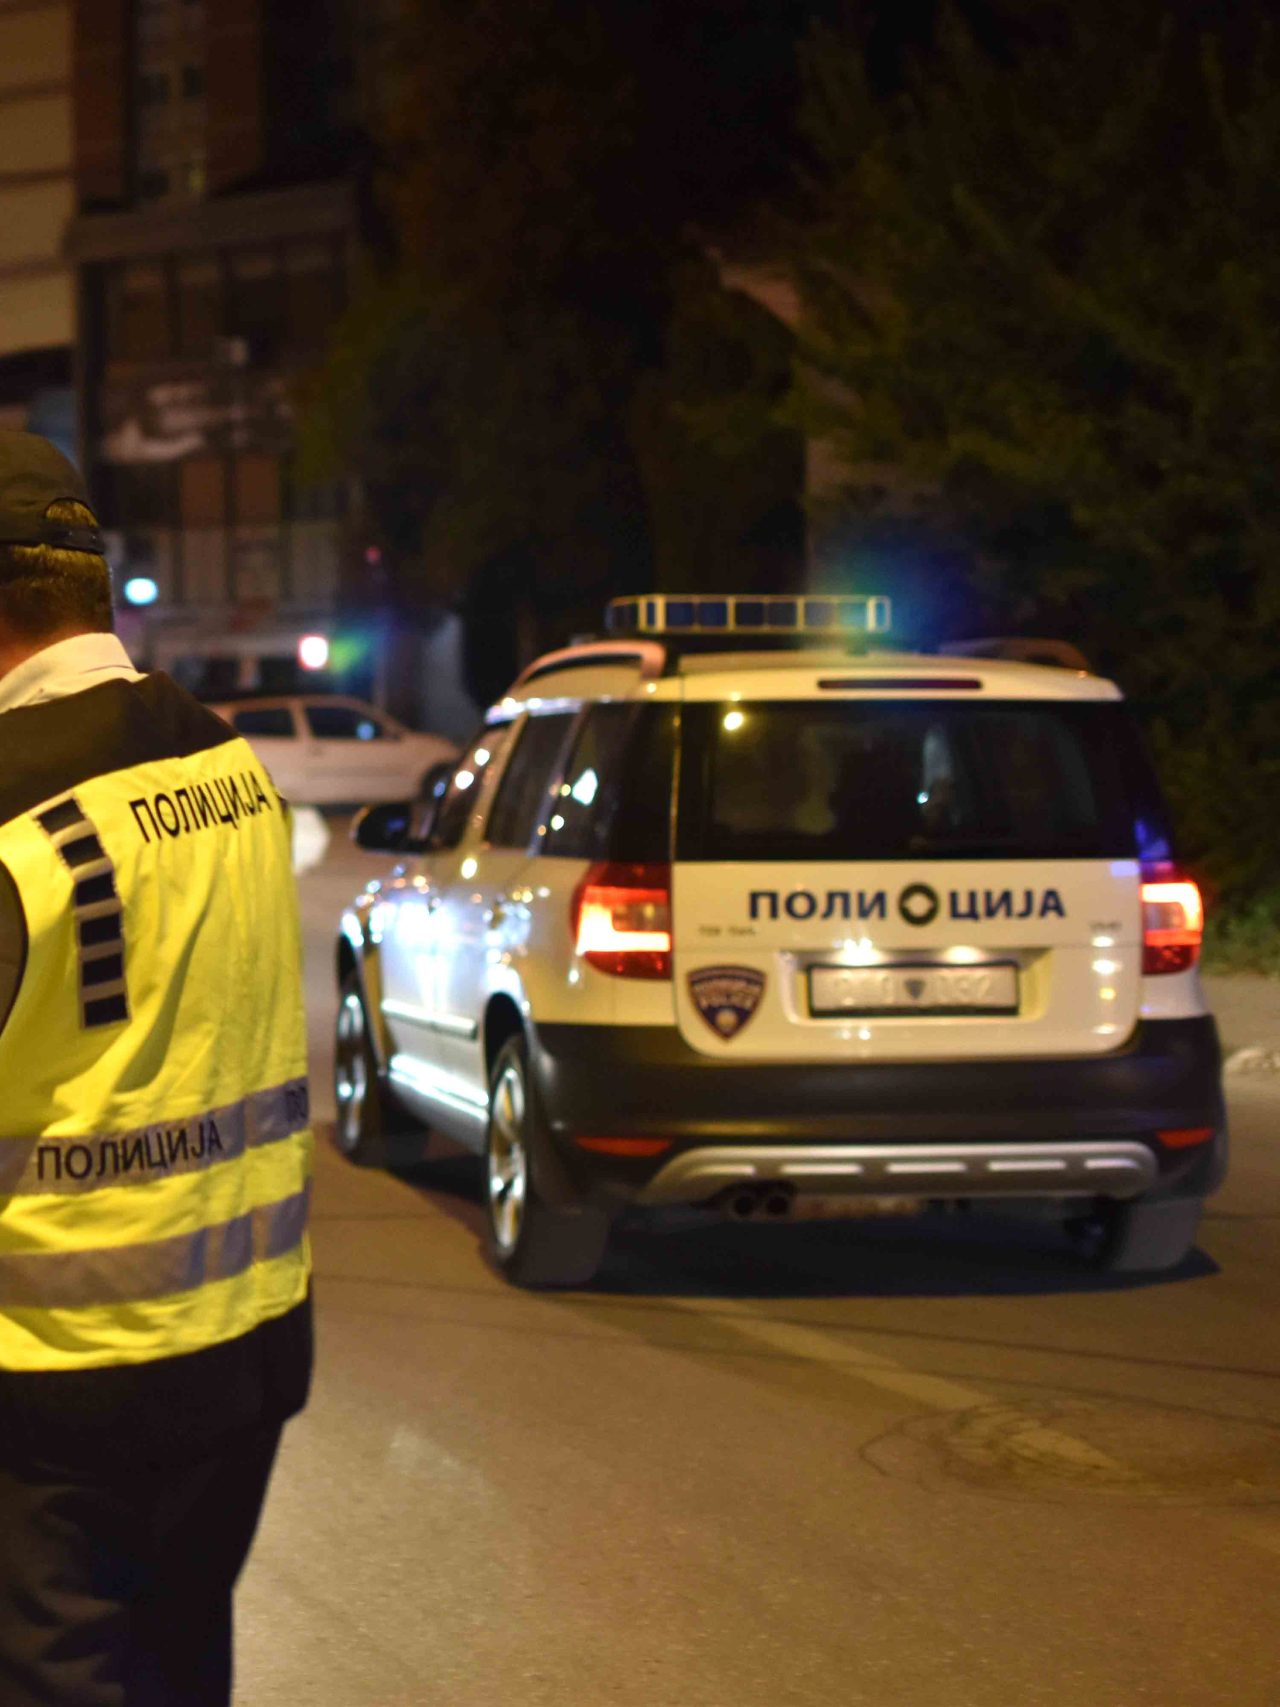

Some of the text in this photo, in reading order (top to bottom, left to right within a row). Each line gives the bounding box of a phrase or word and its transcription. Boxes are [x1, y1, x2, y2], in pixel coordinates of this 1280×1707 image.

[128, 770, 273, 844] ПОЛИЦИЈА
[748, 890, 887, 920] ПОЛИ
[37, 1118, 224, 1181] ПОЛИЦИЈА
